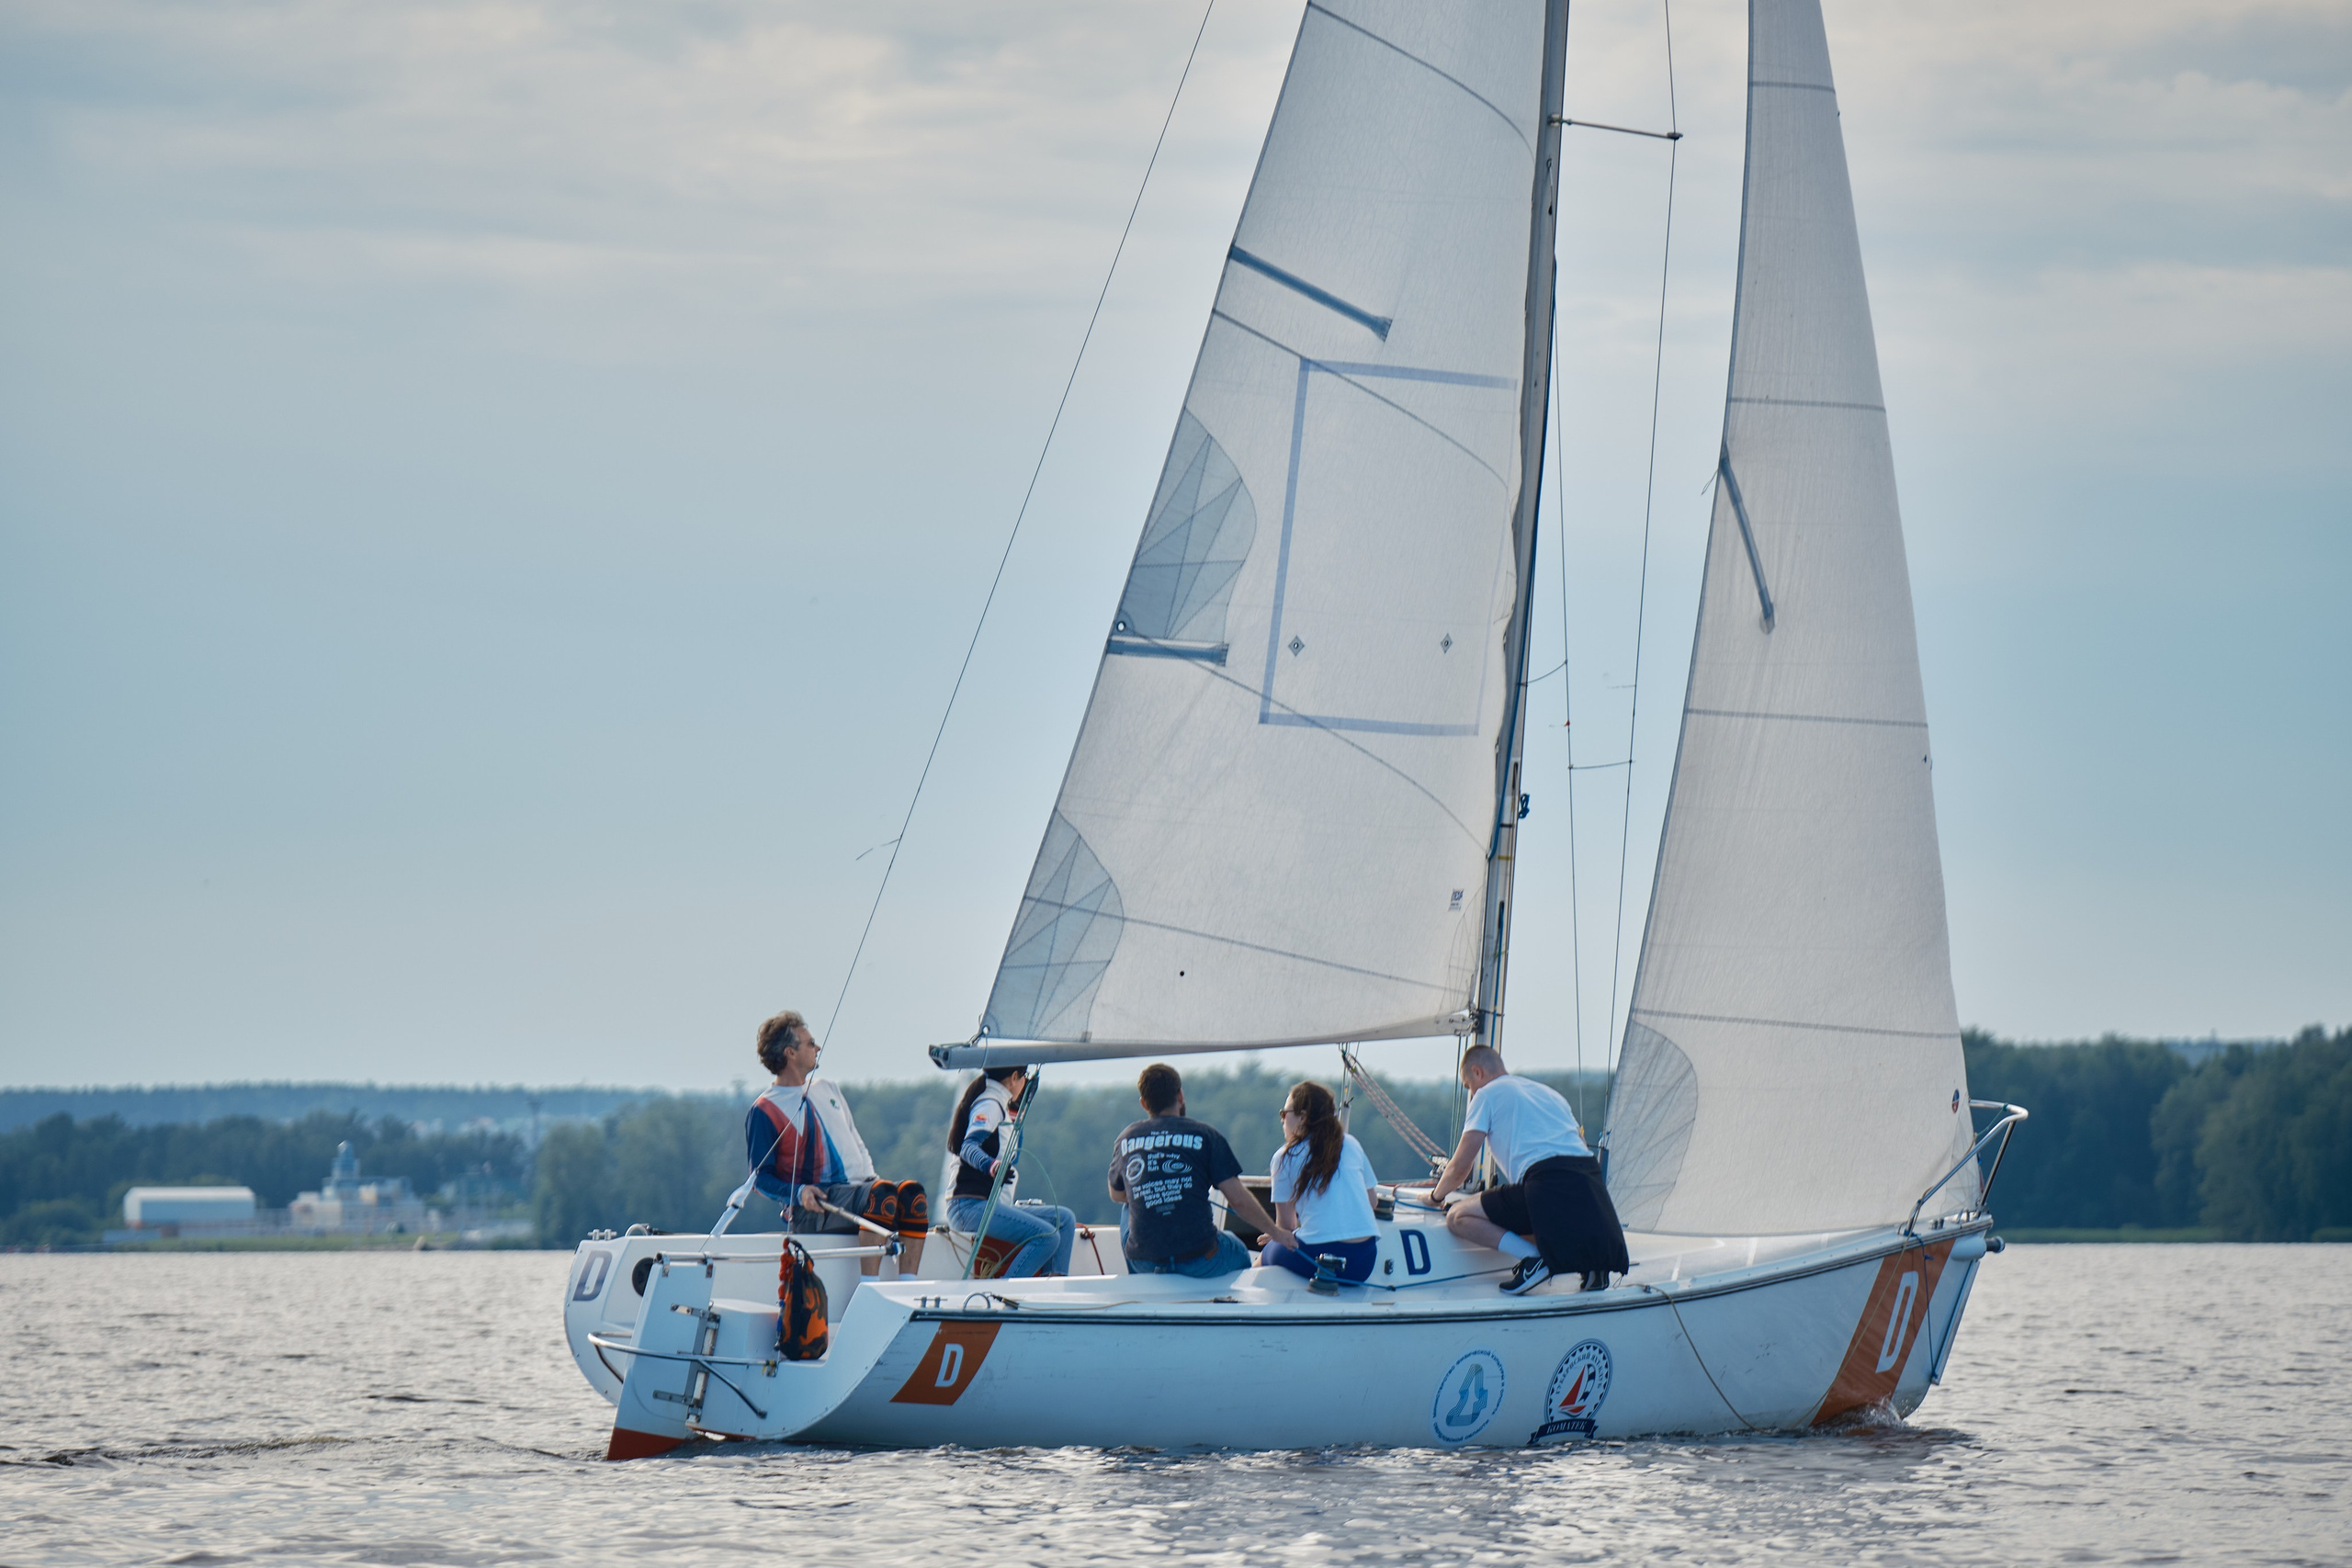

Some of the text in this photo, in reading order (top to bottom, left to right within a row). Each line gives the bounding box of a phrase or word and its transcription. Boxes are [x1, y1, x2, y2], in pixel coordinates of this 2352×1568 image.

[1121, 1134, 1204, 1157] Dangerous
[1142, 1179, 1163, 1190] voices
[1144, 1192, 1160, 1201] have
[1145, 1197, 1162, 1209] good
[1163, 1194, 1182, 1203] ideas
[1399, 1229, 1431, 1275] D
[572, 1250, 613, 1302] D
[1875, 1270, 1919, 1373] D
[934, 1343, 964, 1388] D
[1555, 1351, 1590, 1394] ГУБЕРНСКИЙ
[1546, 1421, 1588, 1433] КОМАТЕК
